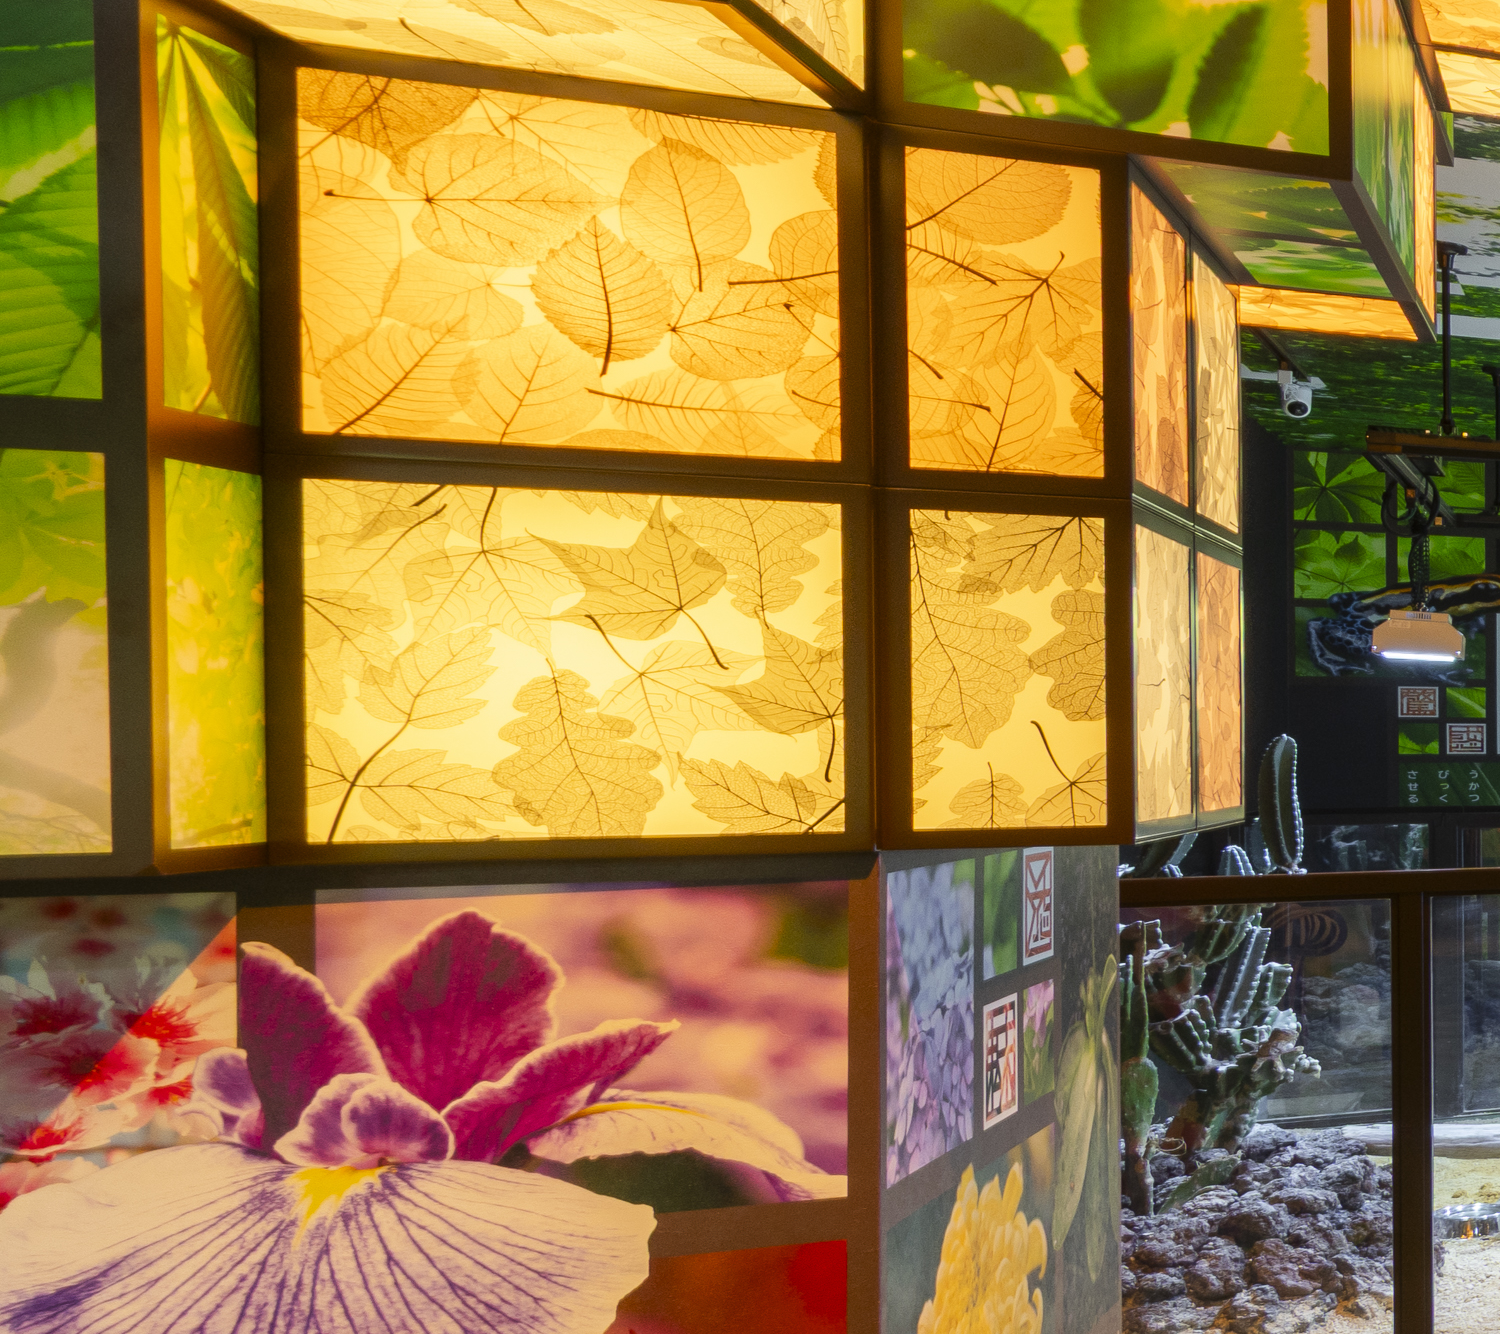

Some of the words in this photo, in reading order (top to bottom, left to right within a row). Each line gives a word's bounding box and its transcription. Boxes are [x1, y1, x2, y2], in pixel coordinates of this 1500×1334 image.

[1407, 770, 1419, 804] させる
[1468, 770, 1480, 802] うかつ
